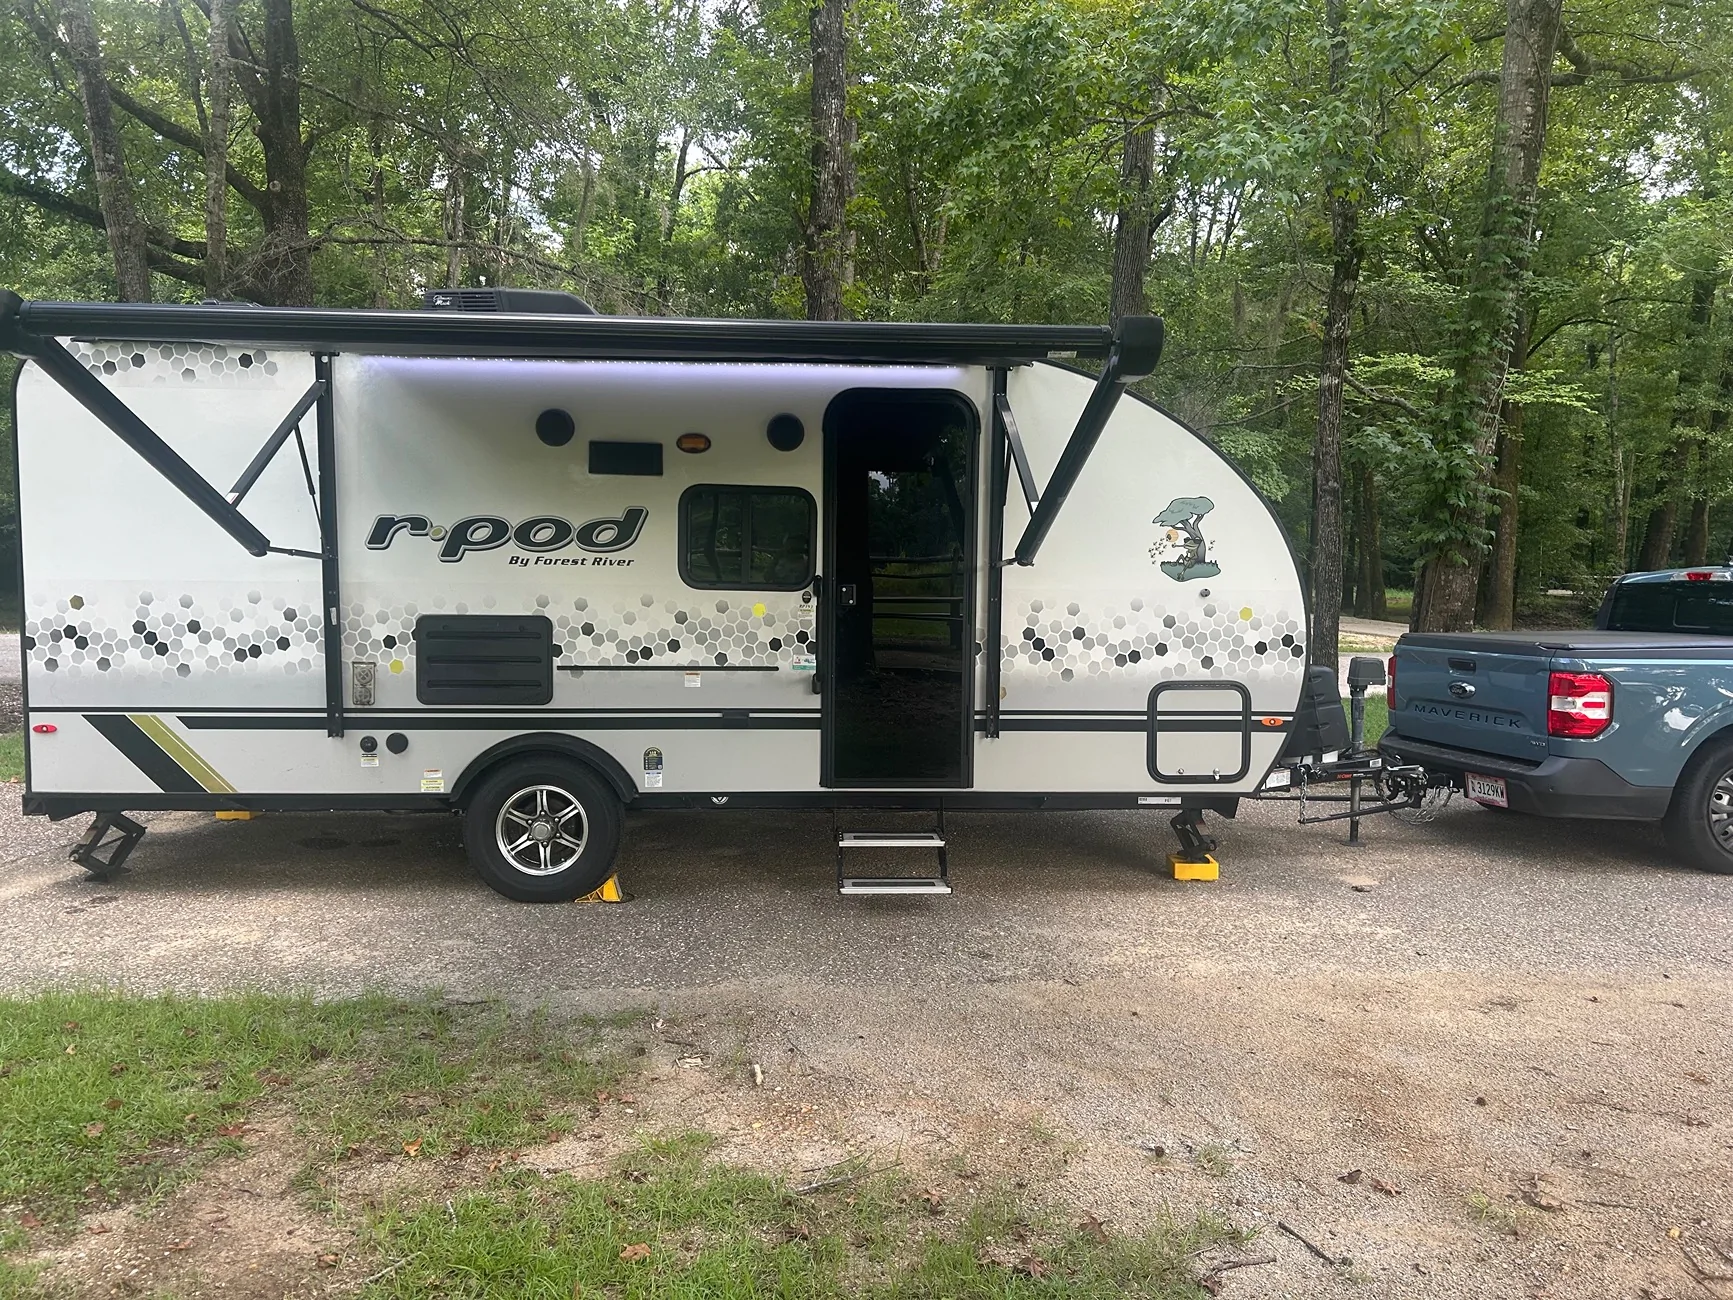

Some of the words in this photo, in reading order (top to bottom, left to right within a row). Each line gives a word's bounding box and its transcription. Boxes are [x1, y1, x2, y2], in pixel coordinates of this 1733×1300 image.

[508, 555, 530, 567] By
[534, 556, 587, 566] Forest
[592, 557, 635, 567] River
[1414, 704, 1521, 729] MAVERICK
